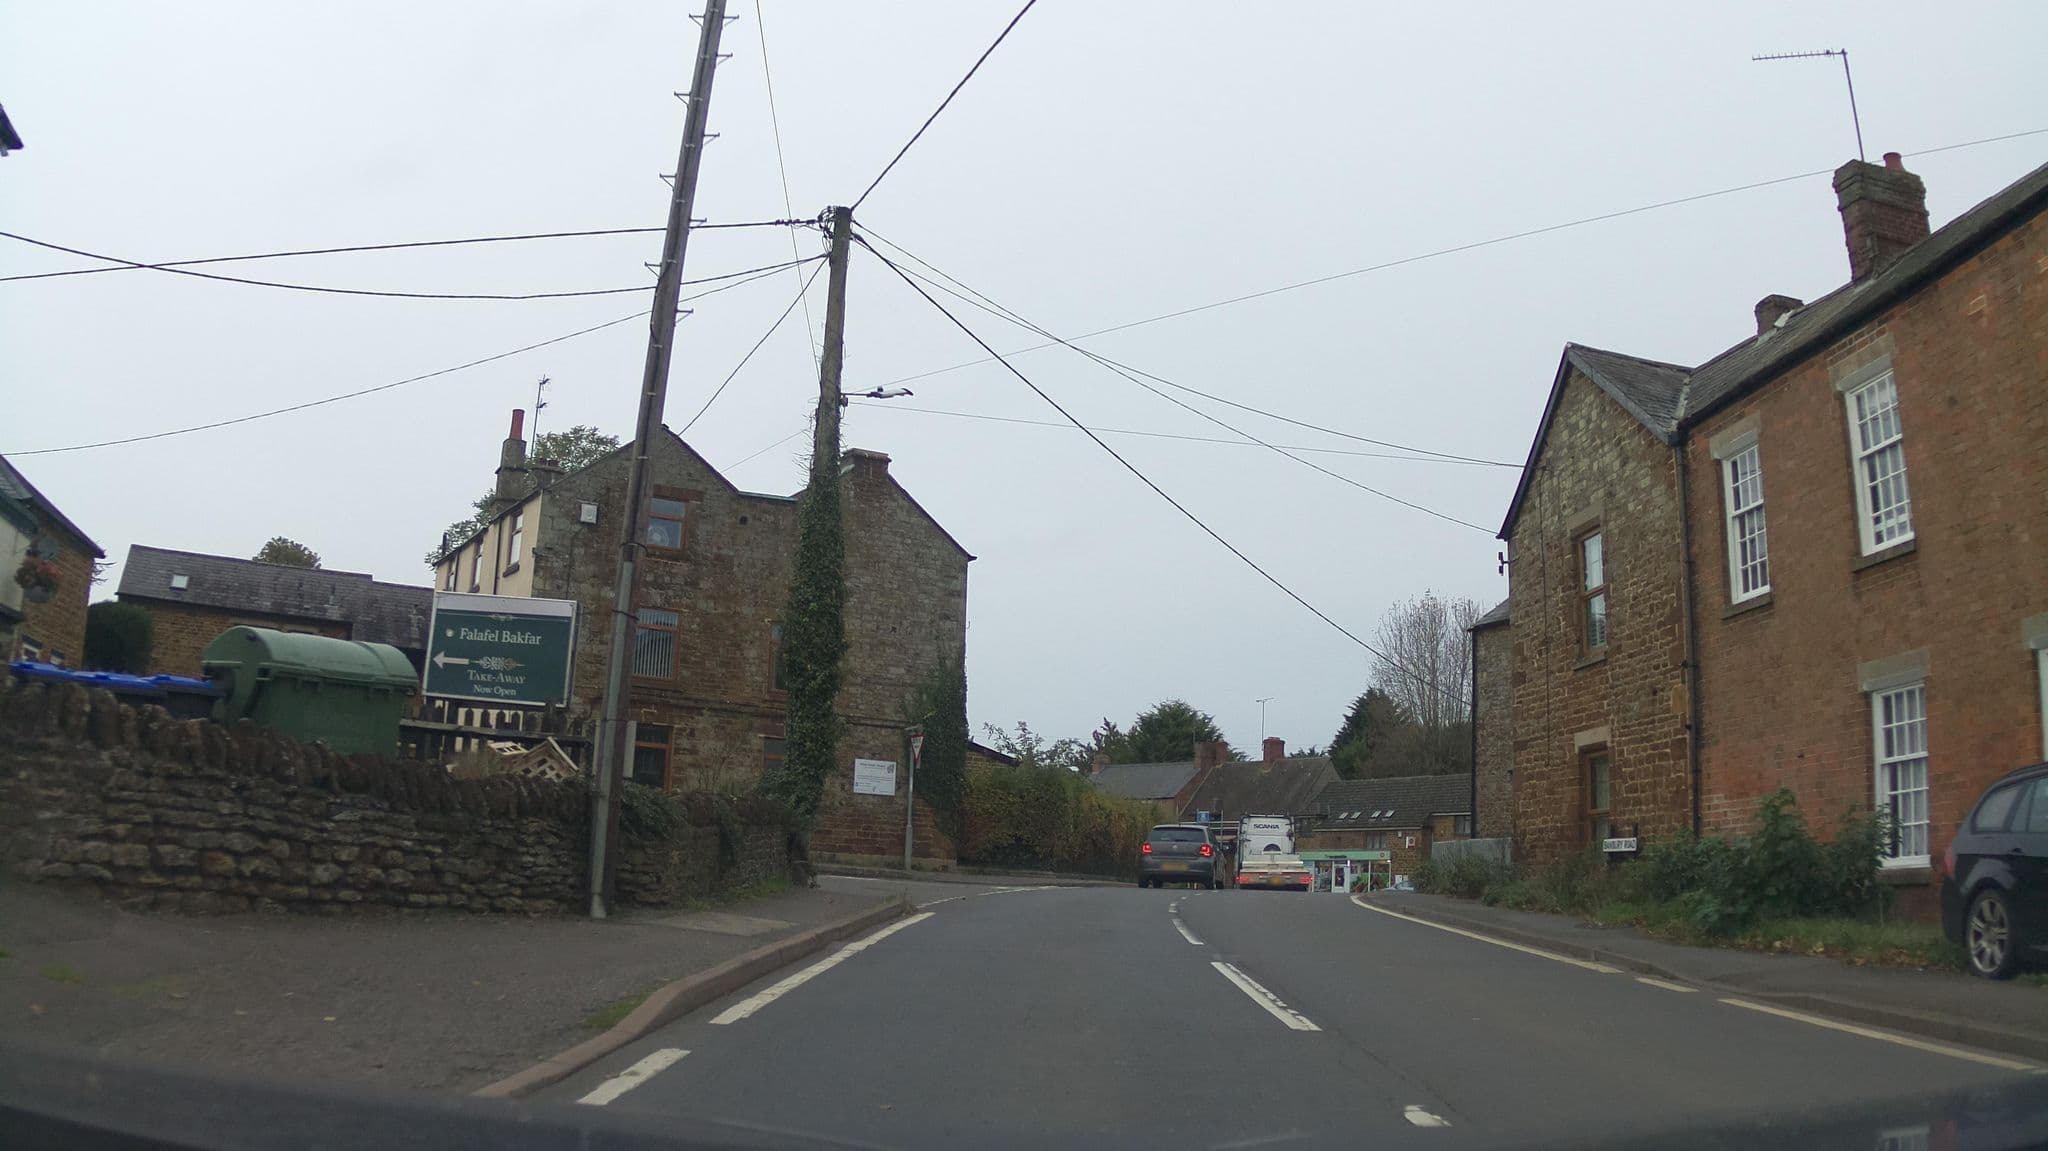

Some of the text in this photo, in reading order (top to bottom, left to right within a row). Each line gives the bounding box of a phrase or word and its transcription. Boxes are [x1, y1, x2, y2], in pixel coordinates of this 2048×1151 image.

[460, 628, 541, 645] Falafel Bakfar
[473, 685, 516, 696] Now Open
[1624, 839, 1635, 848] ROAD
